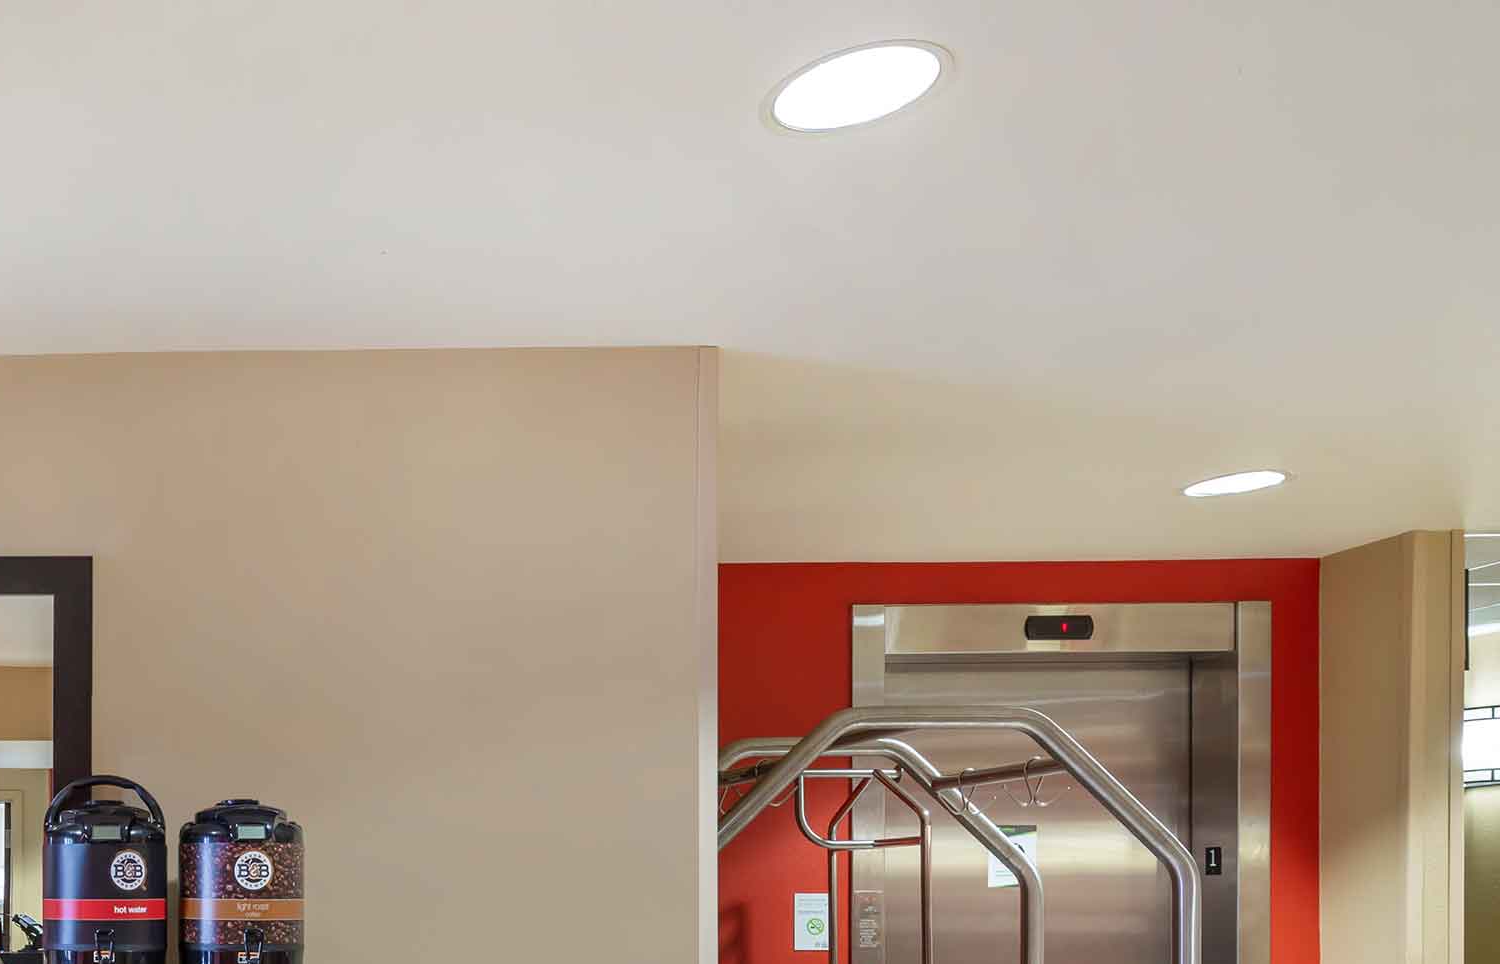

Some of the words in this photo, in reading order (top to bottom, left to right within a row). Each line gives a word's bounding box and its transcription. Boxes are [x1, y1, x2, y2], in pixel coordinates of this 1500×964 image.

[1209, 849, 1217, 867] 1
[114, 905, 128, 914] hot
[129, 906, 148, 914] water
